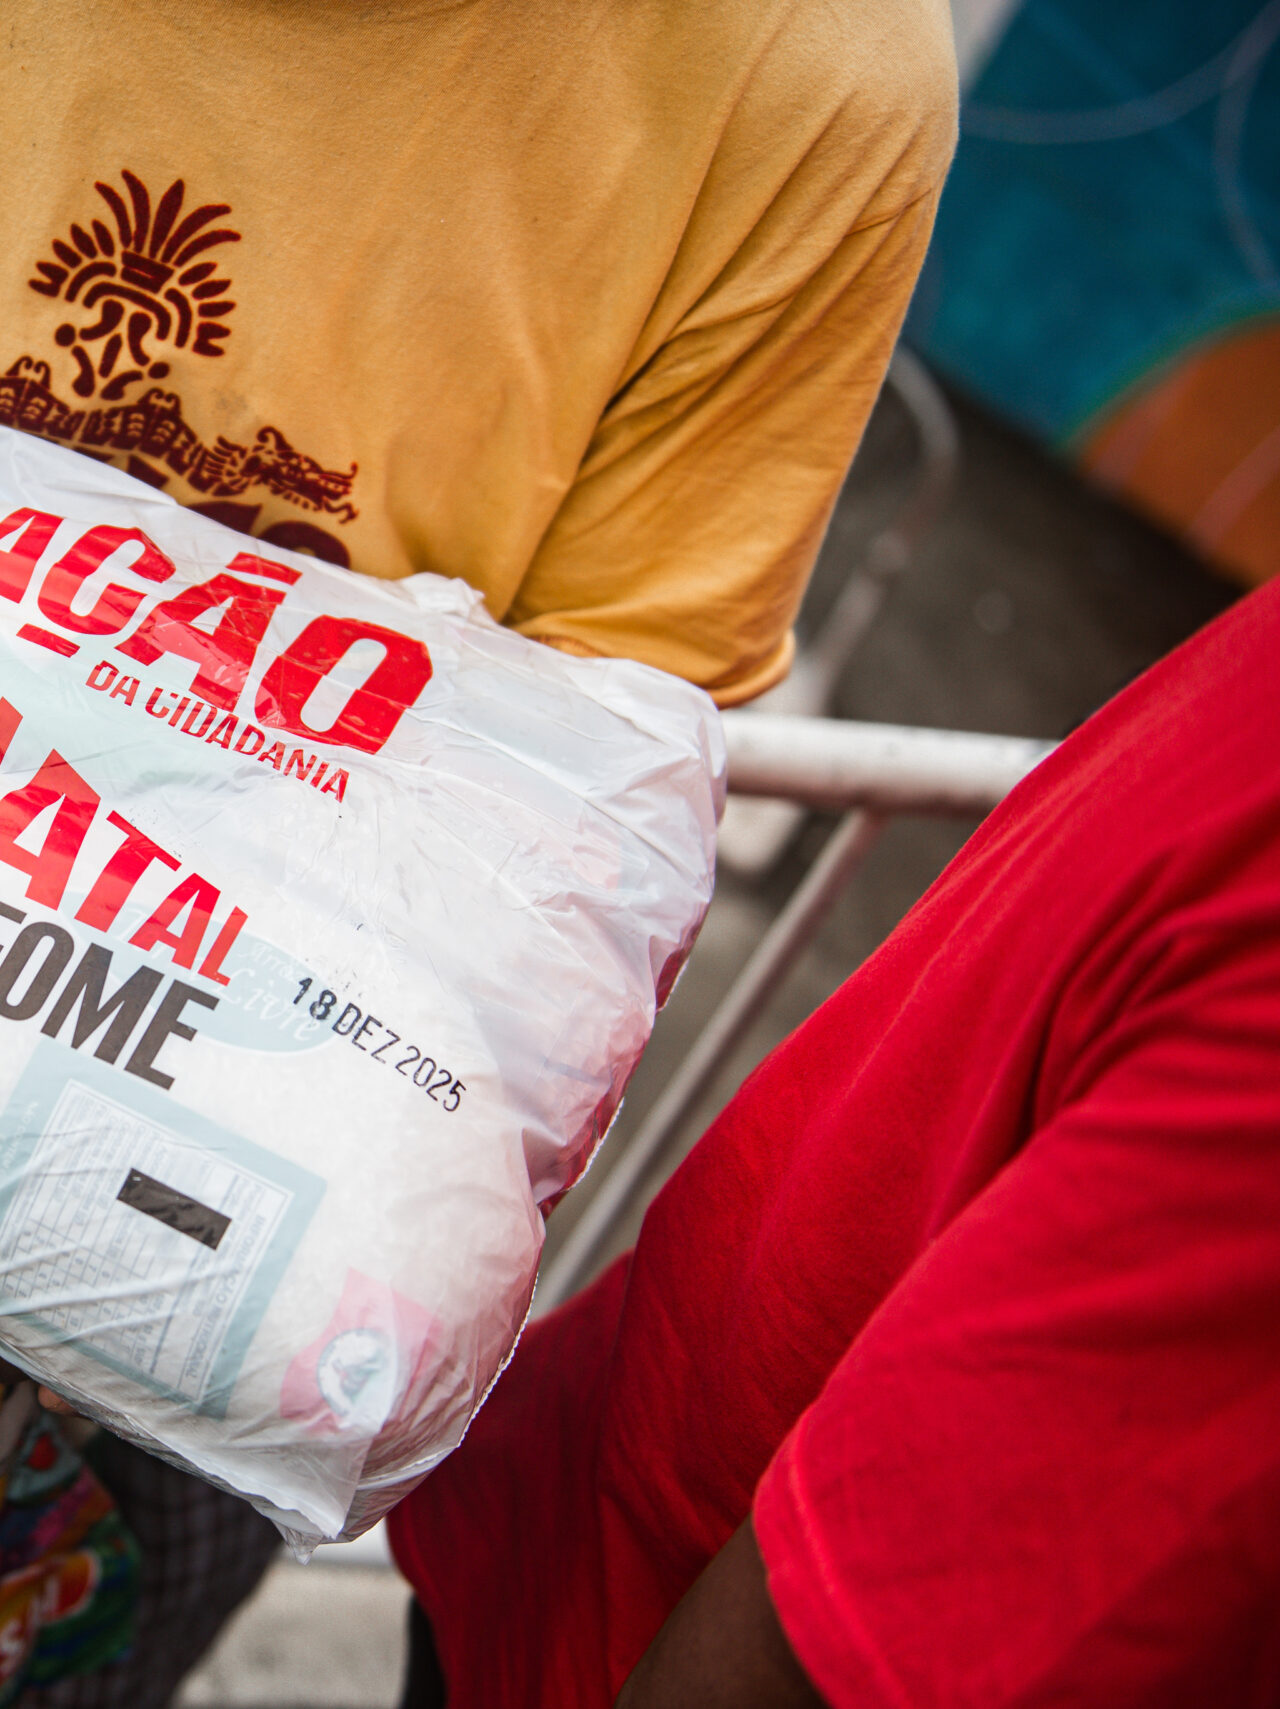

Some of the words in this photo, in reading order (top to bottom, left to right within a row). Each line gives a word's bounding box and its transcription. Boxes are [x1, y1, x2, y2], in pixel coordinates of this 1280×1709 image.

[85, 660, 141, 706] DA
[145, 686, 350, 803] CIDADANIA
[293, 977, 337, 1021] 18
[331, 1003, 400, 1064] DEZ
[395, 1045, 468, 1112] 2025
